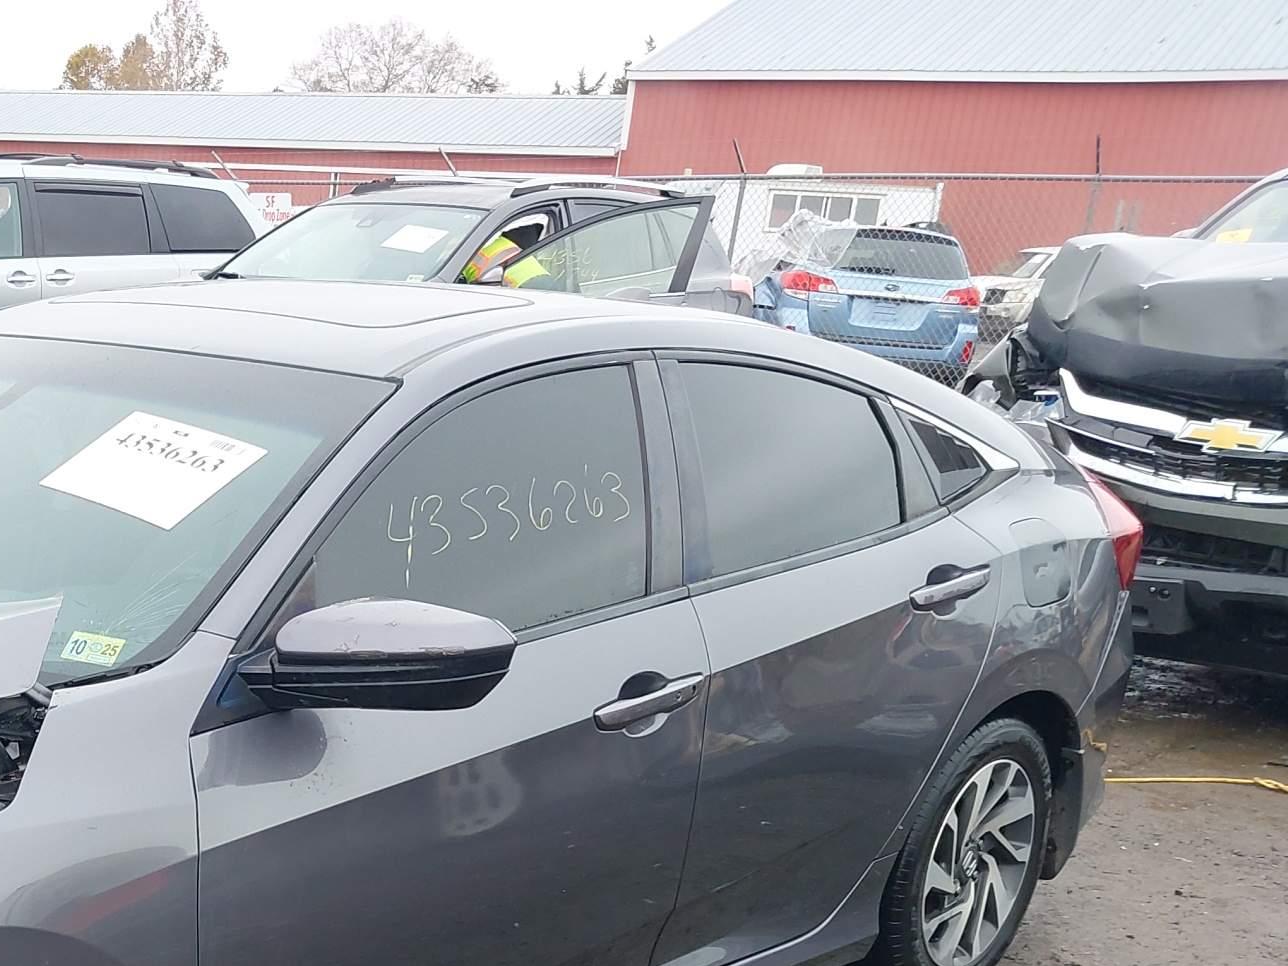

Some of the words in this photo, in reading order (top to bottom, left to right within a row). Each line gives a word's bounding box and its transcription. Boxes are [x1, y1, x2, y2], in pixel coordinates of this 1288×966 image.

[265, 195, 275, 208] SF
[115, 432, 225, 473] 43536263
[387, 464, 631, 588] 43536263
[70, 638, 88, 655] 10
[100, 643, 120, 657] 25
